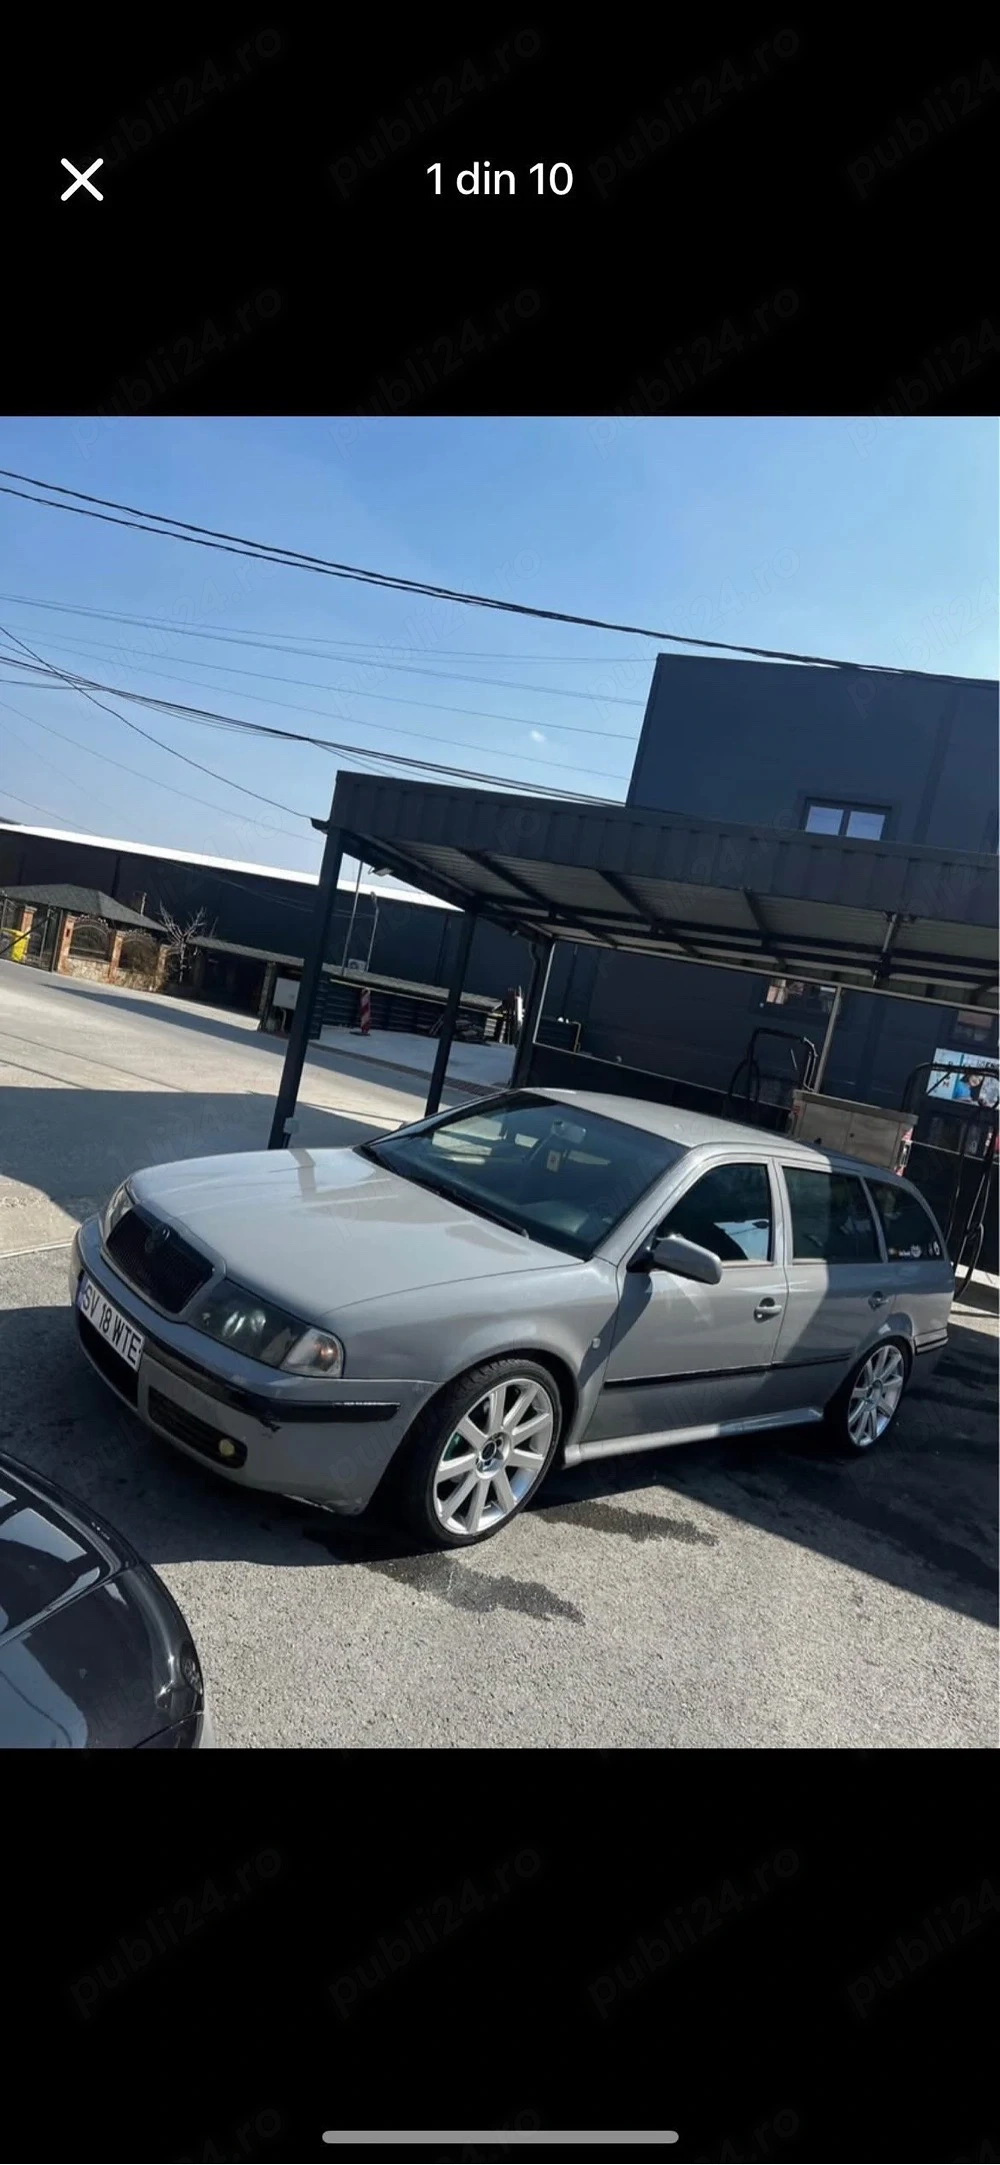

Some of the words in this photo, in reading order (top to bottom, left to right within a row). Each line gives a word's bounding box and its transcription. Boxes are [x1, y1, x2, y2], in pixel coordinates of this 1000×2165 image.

[83, 1285, 100, 1318] SV
[100, 1303, 112, 1334] 18
[112, 1314, 142, 1366] WTE
